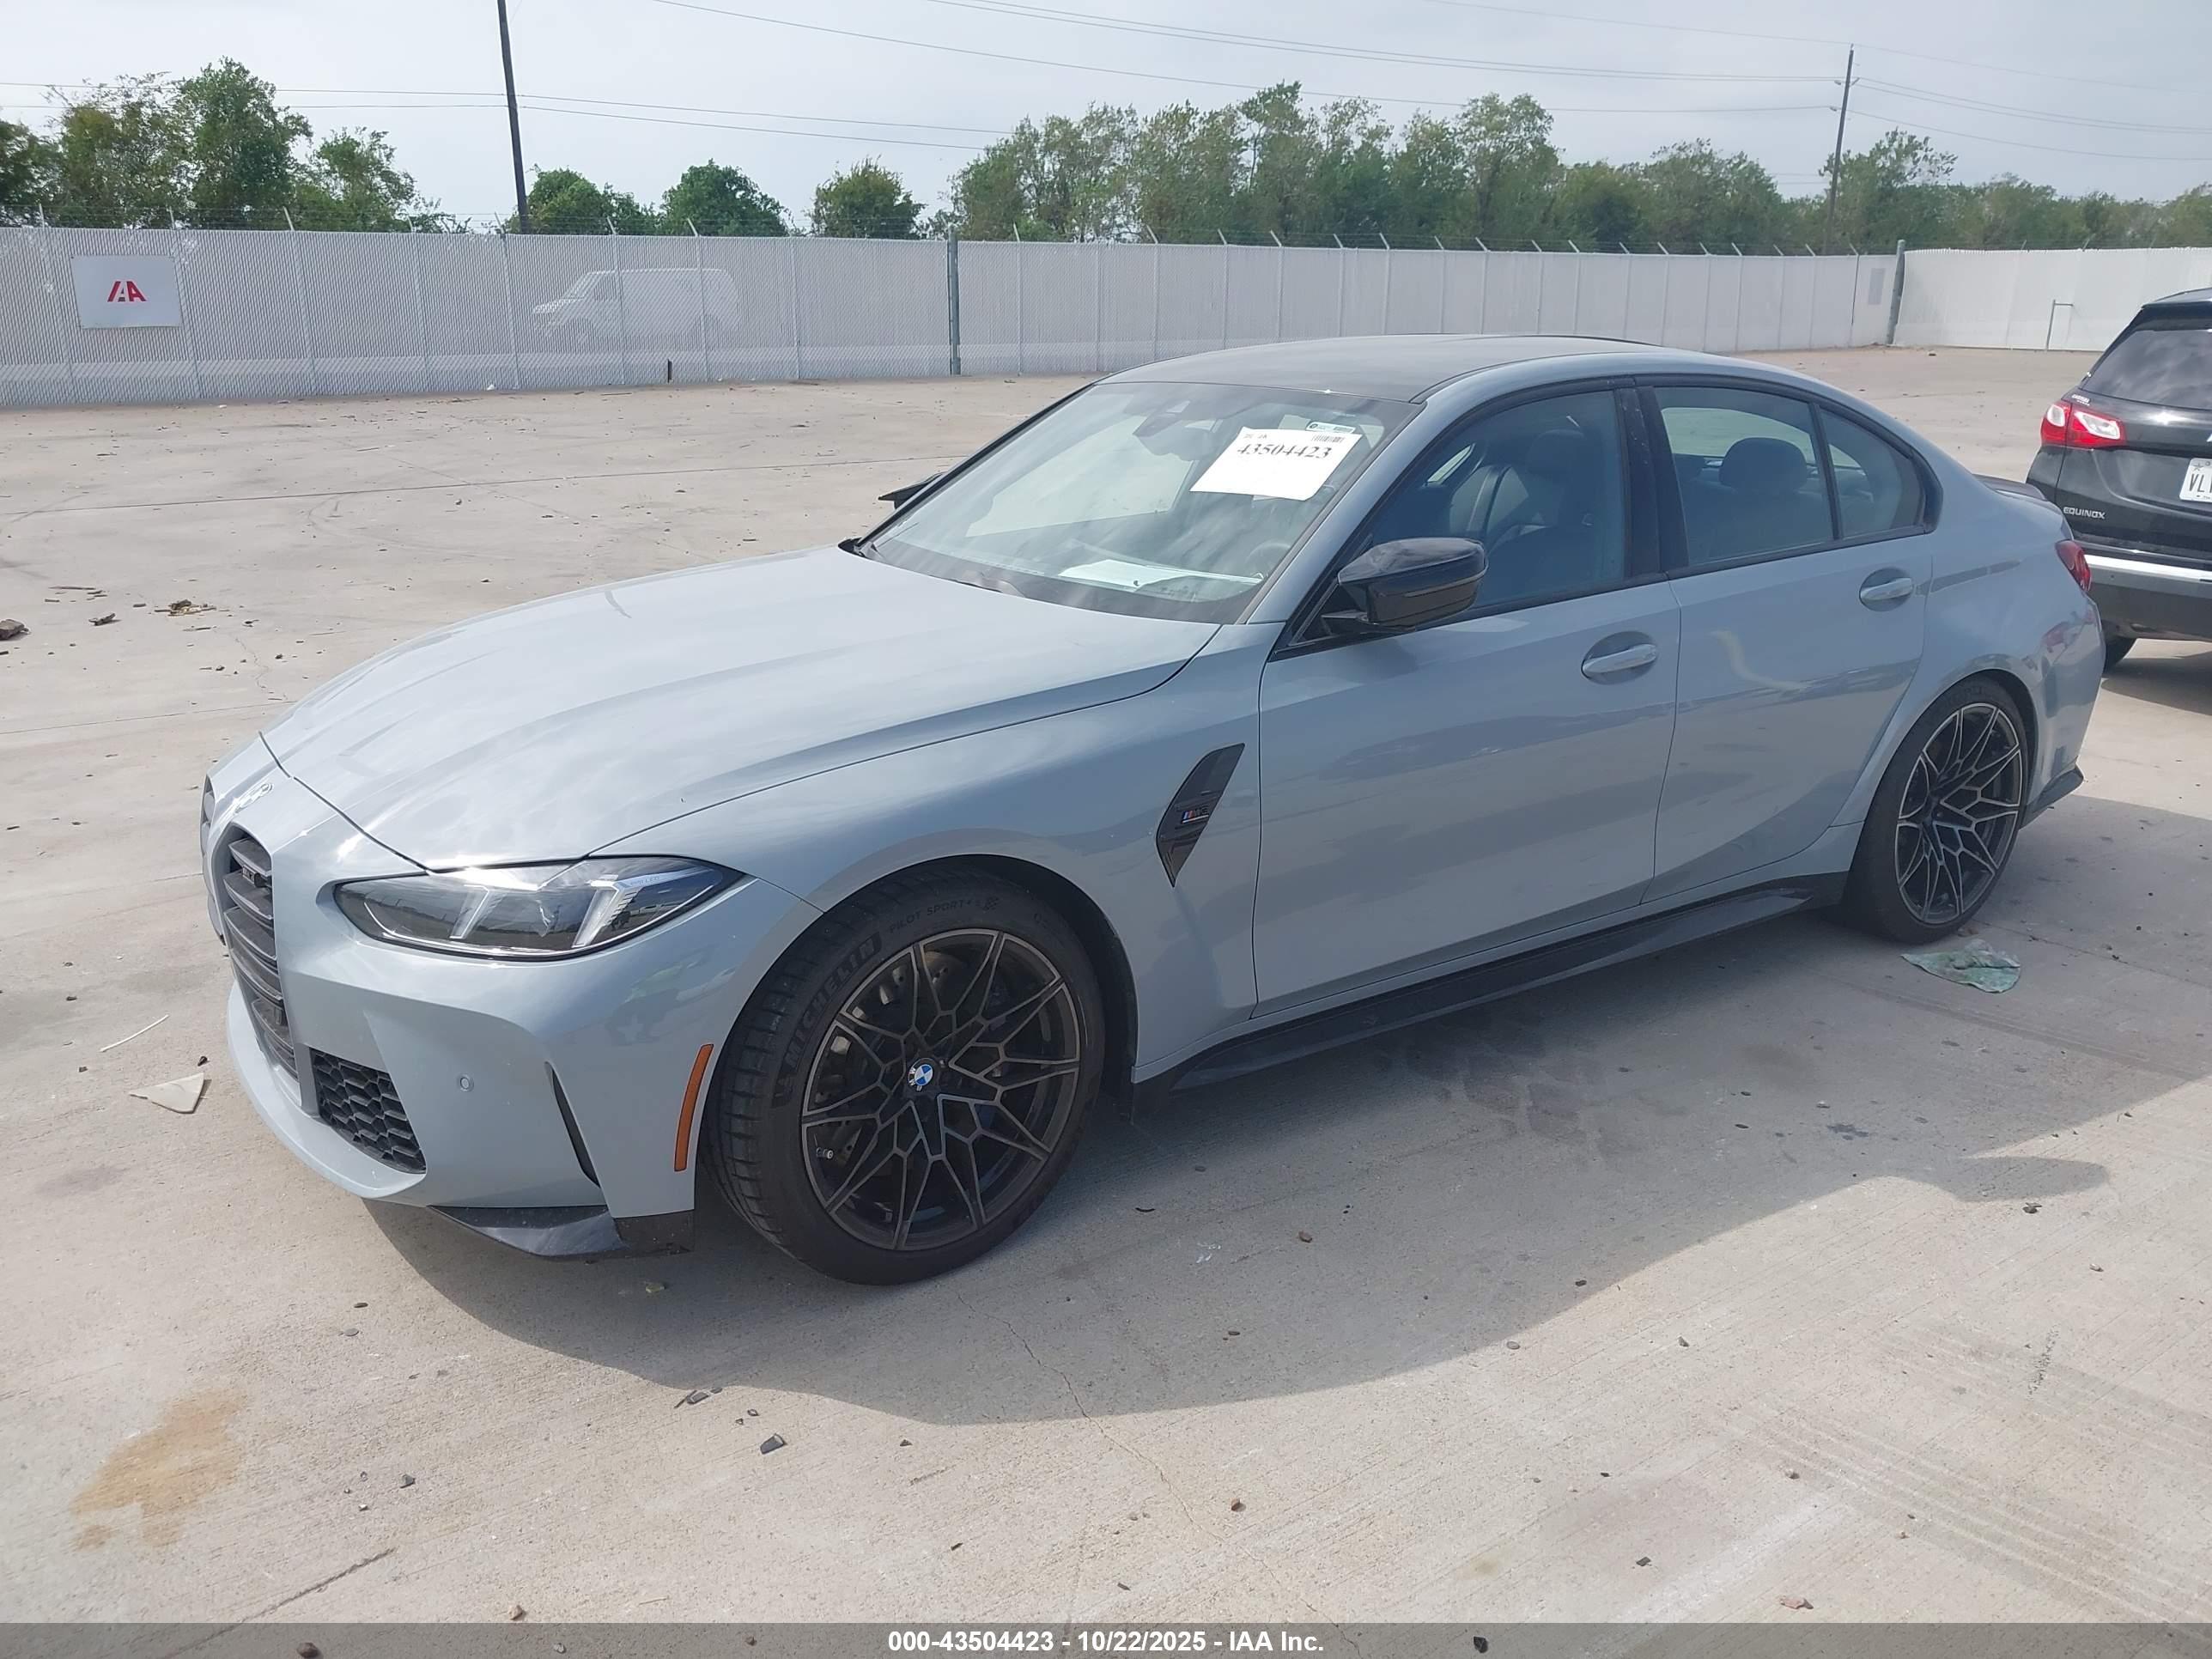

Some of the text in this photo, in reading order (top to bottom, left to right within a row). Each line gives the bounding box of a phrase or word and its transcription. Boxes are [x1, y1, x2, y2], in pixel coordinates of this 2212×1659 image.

[1237, 442, 1333, 459] 43504423
[2188, 473, 2212, 495] VL
[2063, 506, 2106, 520] EQUINOX
[784, 899, 964, 1068] MICHELIN PILOT SPORT
